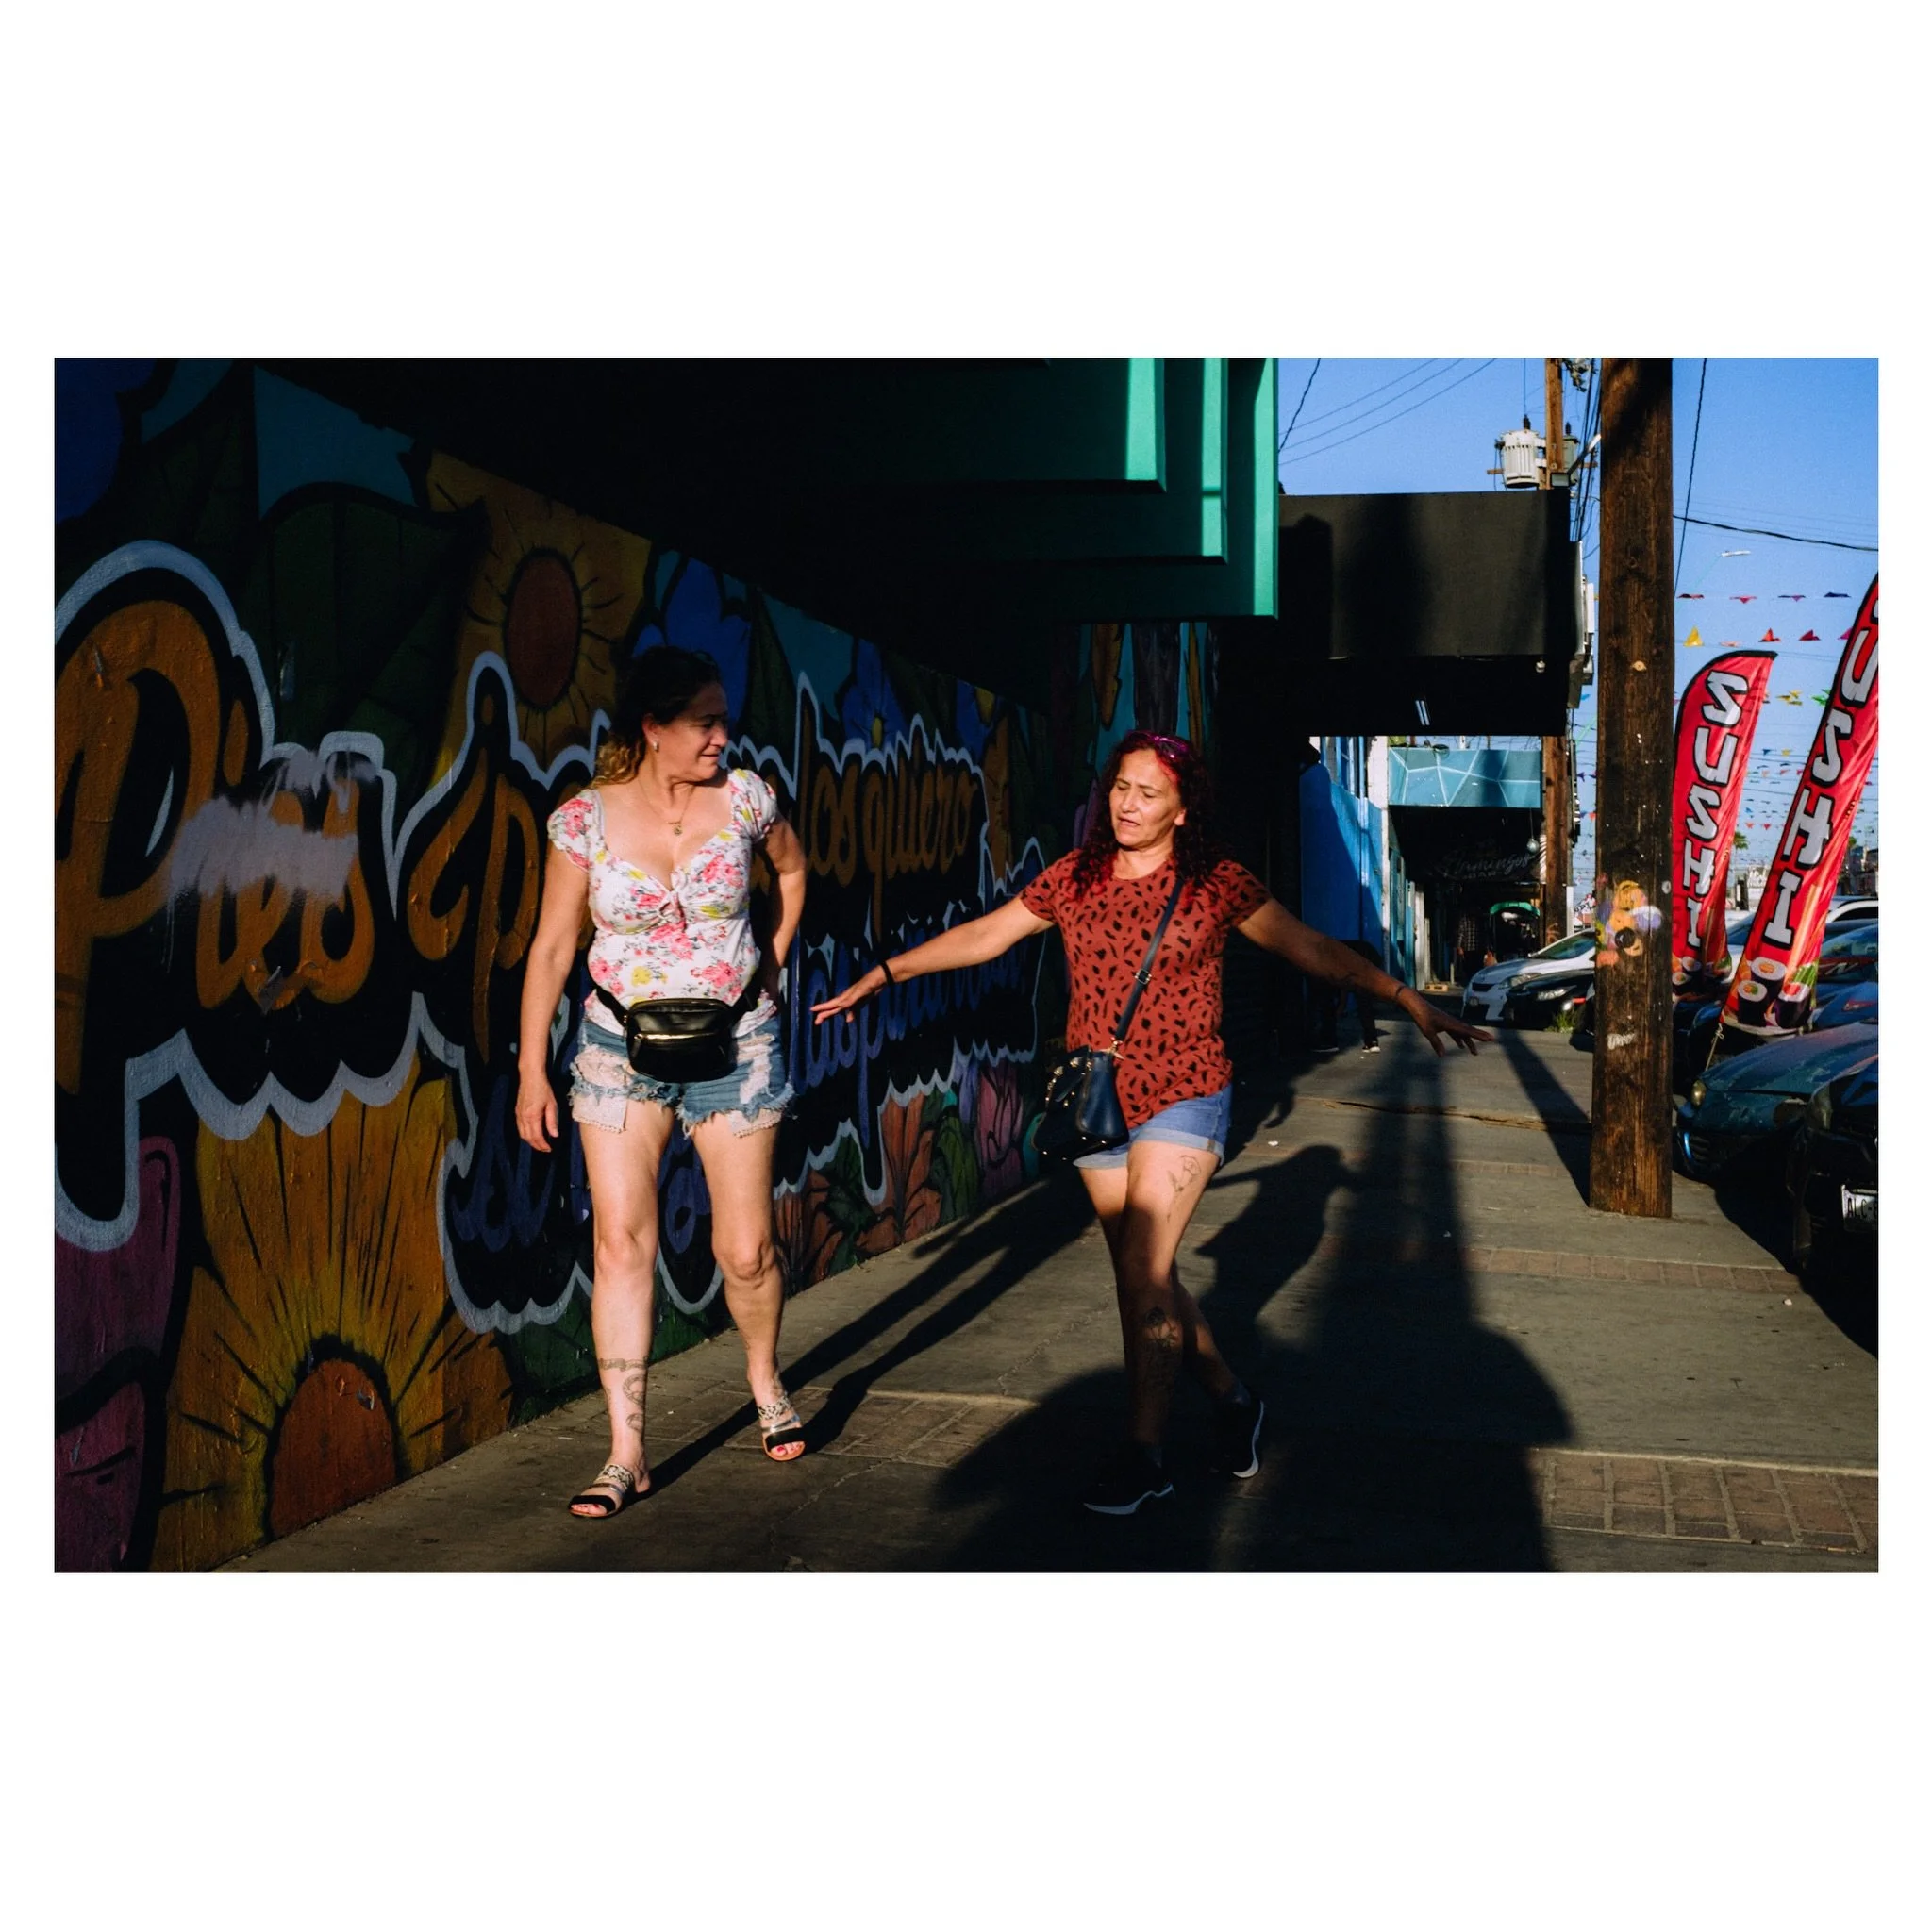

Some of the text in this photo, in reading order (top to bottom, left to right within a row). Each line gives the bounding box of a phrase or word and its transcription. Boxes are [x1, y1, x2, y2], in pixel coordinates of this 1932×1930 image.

[55, 598, 375, 1096] Pies
[798, 704, 859, 889] los
[862, 725, 978, 943] quiero
[1683, 670, 1749, 949] SUSHI
[1763, 600, 1878, 949] USHI
